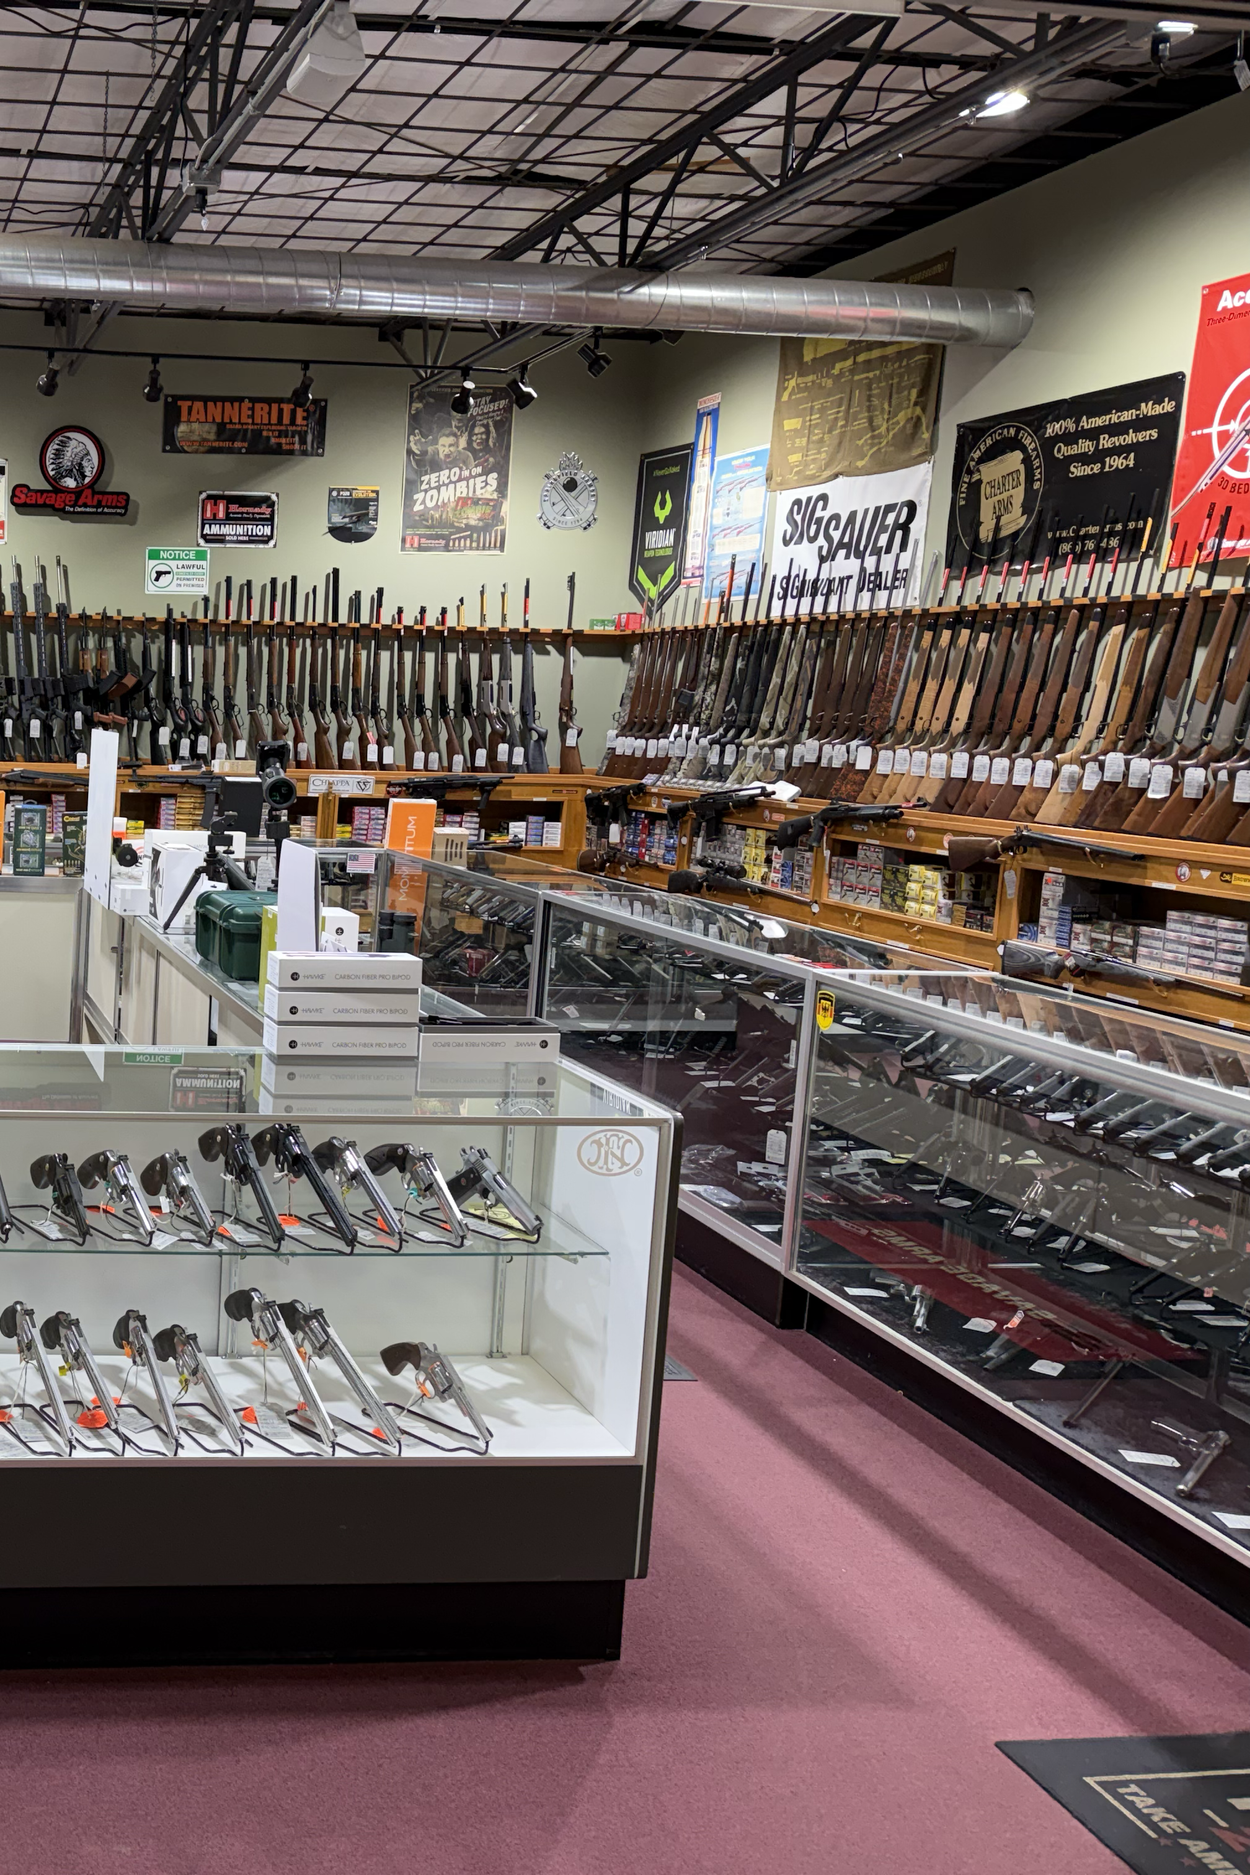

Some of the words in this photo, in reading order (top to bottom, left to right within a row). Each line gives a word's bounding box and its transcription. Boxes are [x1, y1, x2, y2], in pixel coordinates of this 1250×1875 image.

[177, 400, 307, 425] TANNERITE
[1044, 418, 1076, 438] 100%
[1078, 398, 1176, 432] American-Made
[1054, 437, 1096, 460] Quality
[1099, 425, 1159, 449] Revolvers
[421, 467, 460, 490] ZERO
[461, 469, 470, 479] IN
[471, 466, 482, 476] ON
[959, 474, 971, 506] FINE
[970, 427, 1017, 470] AMERICAN
[1017, 430, 1041, 490] FIREARMS
[1069, 460, 1101, 478] Since
[1104, 452, 1135, 473] 1964
[13, 487, 76, 508] Savage
[77, 488, 127, 506] Arms
[413, 472, 499, 512] ZOMBIES
[984, 468, 1022, 501] CHARTER
[228, 504, 273, 514] Hornady
[782, 492, 829, 547] SIG
[991, 495, 1014, 521] ARMS
[645, 528, 676, 549] VIRIDIAN
[817, 499, 918, 565] SAUER
[159, 551, 196, 559] NOTICE
[1116, 1783, 1192, 1835] TAKE
